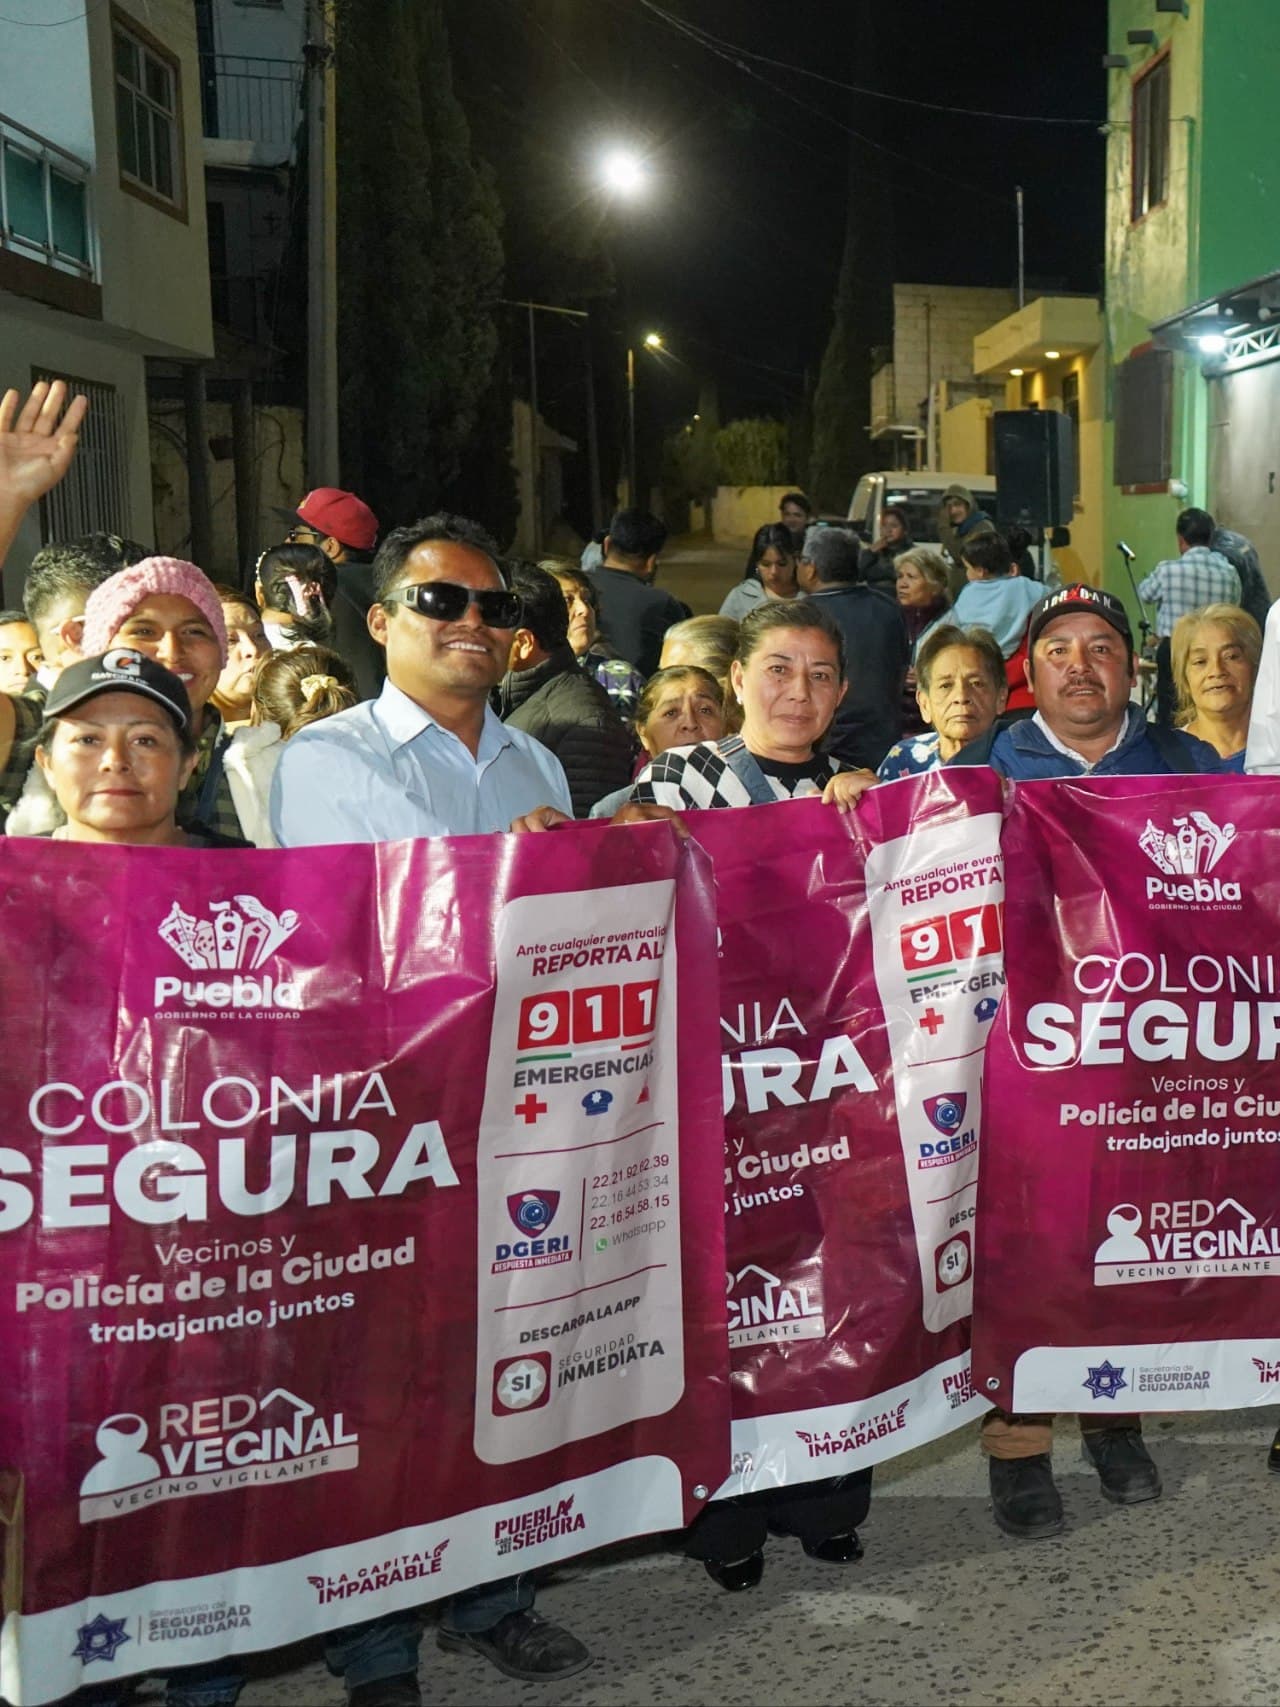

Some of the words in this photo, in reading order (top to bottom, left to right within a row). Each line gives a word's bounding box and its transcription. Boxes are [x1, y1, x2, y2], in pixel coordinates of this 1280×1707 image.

[884, 878, 911, 892] Ante
[914, 862, 969, 882] cualquier
[1146, 876, 1242, 902] Puebla
[516, 945, 547, 957] Ante
[549, 934, 605, 953] cualquier
[532, 944, 632, 977] REPORTA
[154, 975, 303, 1009] Puebla
[154, 1011, 217, 1020] GOBIERNO
[221, 1011, 235, 1020] DE
[238, 1011, 253, 1020] LA
[255, 1011, 300, 1020] CIUDAD
[528, 988, 653, 1041] 911
[1151, 1076, 1228, 1093] Vecinos
[1233, 1077, 1246, 1093] y
[28, 1072, 397, 1137] COLONIA
[1060, 1100, 1157, 1126] Policía
[1163, 1098, 1196, 1121] de
[1202, 1096, 1227, 1118] la
[733, 1137, 744, 1156] y
[920, 1129, 974, 1158] DGERI
[1107, 1129, 1221, 1153] trabajando
[738, 1136, 850, 1179] Ciudad
[733, 1184, 804, 1216] juntos
[1150, 1200, 1215, 1230] RED
[155, 1238, 273, 1266] Vecinos
[280, 1234, 297, 1257] y
[495, 1235, 569, 1261] DGERI
[946, 1252, 959, 1270] SI
[16, 1275, 164, 1312] Policía
[174, 1271, 226, 1301] de
[237, 1265, 273, 1293] la
[282, 1236, 416, 1285] Ciudad
[1116, 1267, 1176, 1278] VECINO
[1185, 1261, 1271, 1274] VIGILANTE
[89, 1305, 262, 1344] trabajando
[267, 1291, 355, 1327] juntos
[519, 1310, 595, 1343] DESCARGA
[614, 1296, 640, 1314] APP
[558, 1340, 665, 1388] INMEDIATA
[559, 1333, 635, 1369] SEGURIDAD
[511, 1374, 531, 1392] SI
[1139, 1371, 1210, 1383] SEGURIDAD
[1139, 1381, 1210, 1392] CIUDADANA
[159, 1394, 257, 1439] RED
[815, 1432, 831, 1441] LA
[839, 1411, 897, 1438] CAPITAL
[160, 1412, 358, 1476] VECINAL
[808, 1415, 906, 1457] IMPARABLE
[112, 1479, 199, 1510] VECINO
[212, 1455, 330, 1488] VIGILANTE
[494, 1497, 571, 1539] PUEBLA
[512, 1512, 586, 1551] SEGURA
[318, 1557, 442, 1604] IMPARABLE
[328, 1573, 349, 1588] LA
[357, 1551, 432, 1578] CAPITAL
[148, 1616, 252, 1642] CIUDADANA
[149, 1604, 252, 1631] SEGURIDAD
